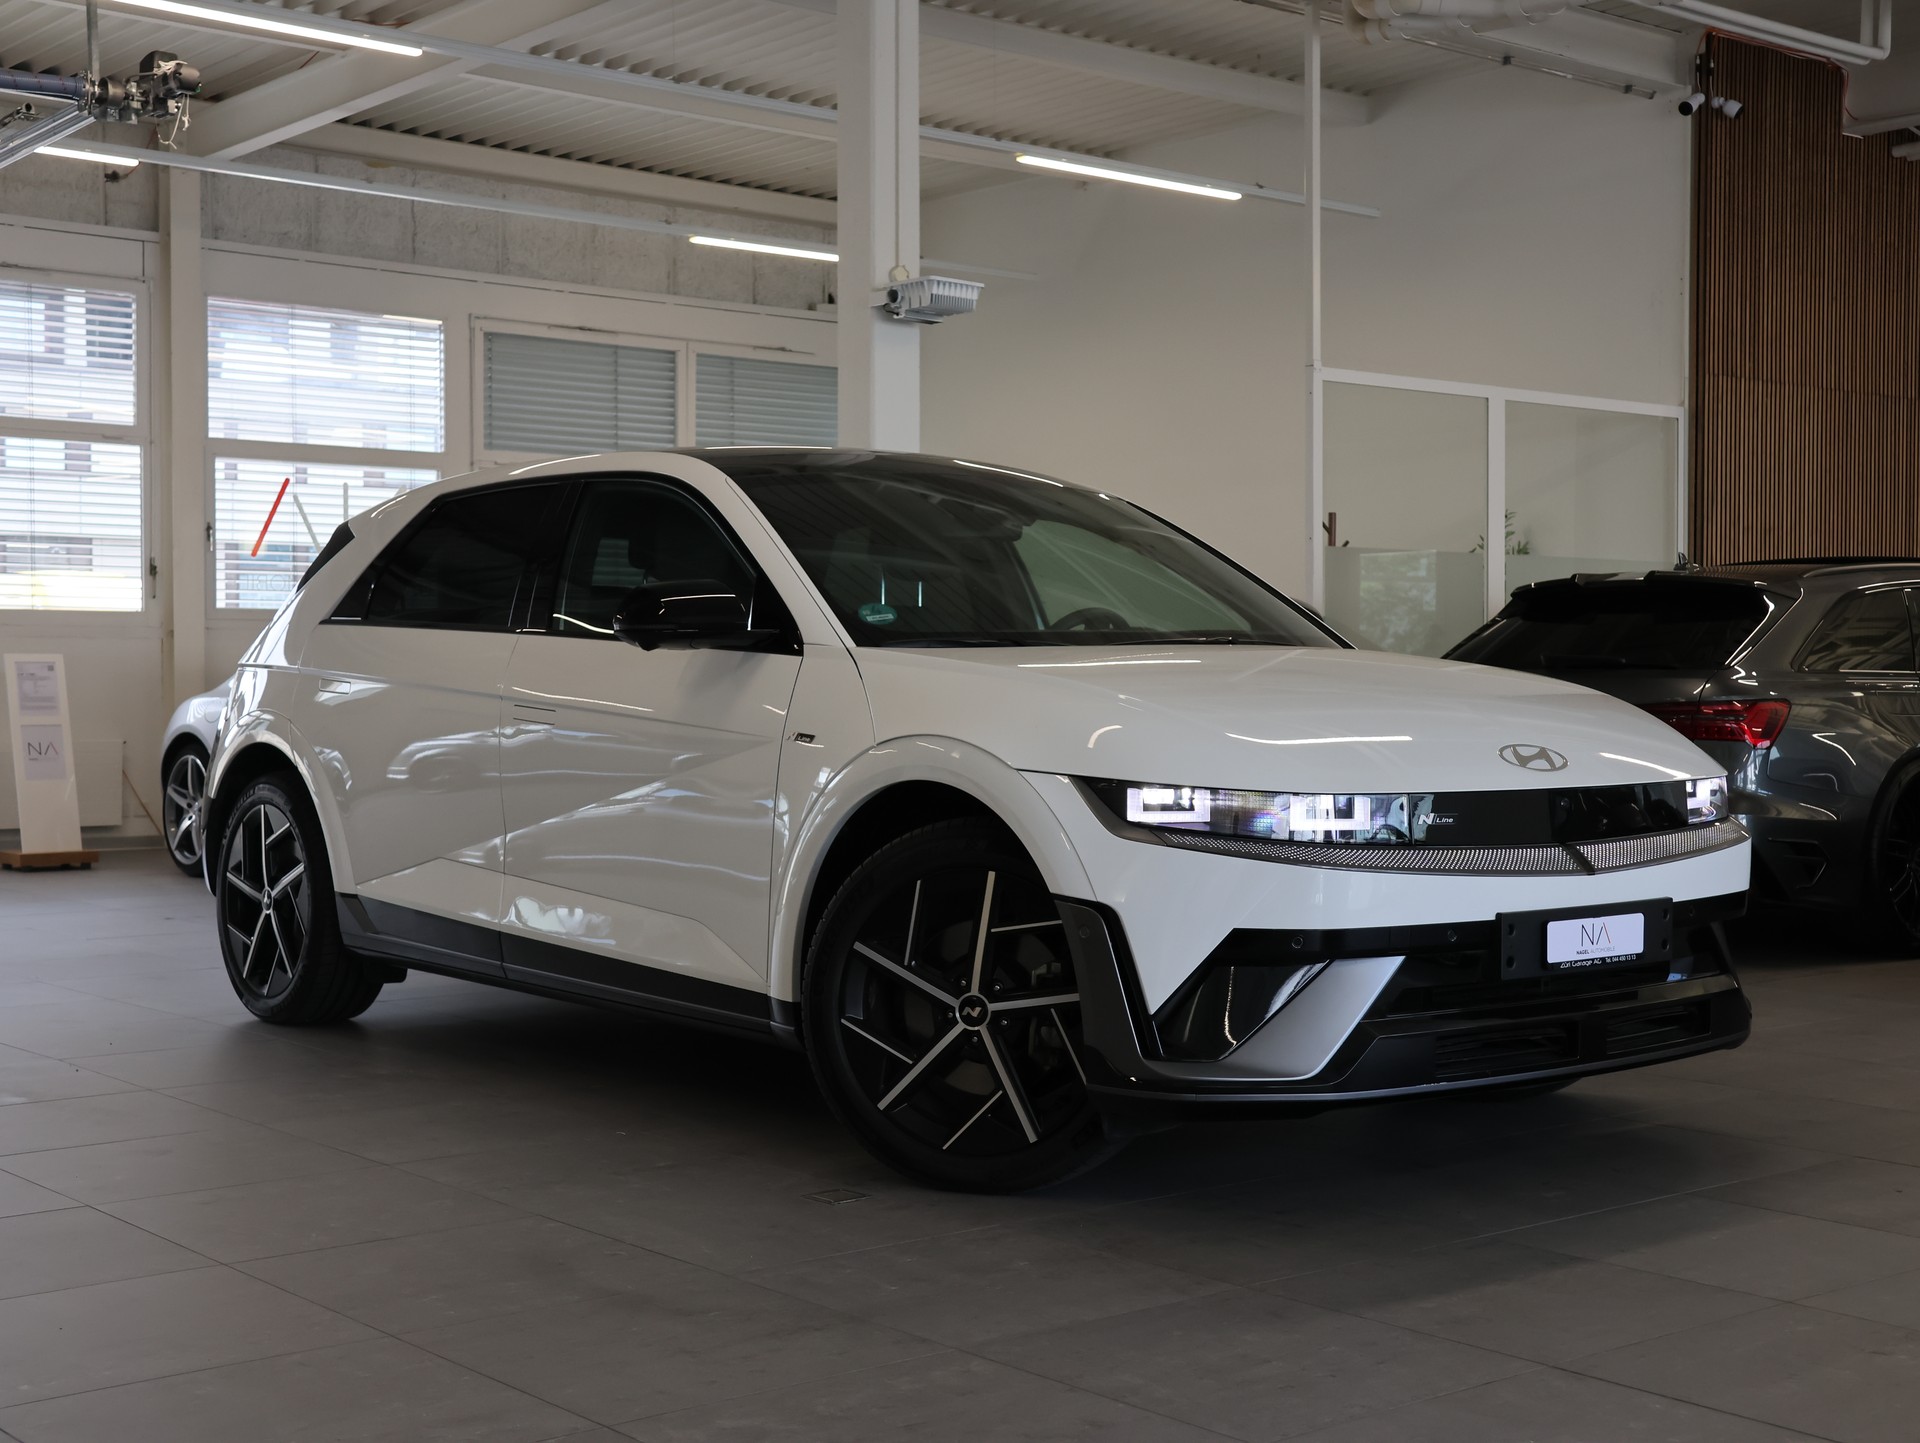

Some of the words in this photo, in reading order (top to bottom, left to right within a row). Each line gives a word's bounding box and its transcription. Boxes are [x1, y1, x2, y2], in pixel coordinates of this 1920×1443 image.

[27, 742, 58, 756] NA
[1418, 812, 1435, 825] N
[1581, 922, 1611, 947] NA
